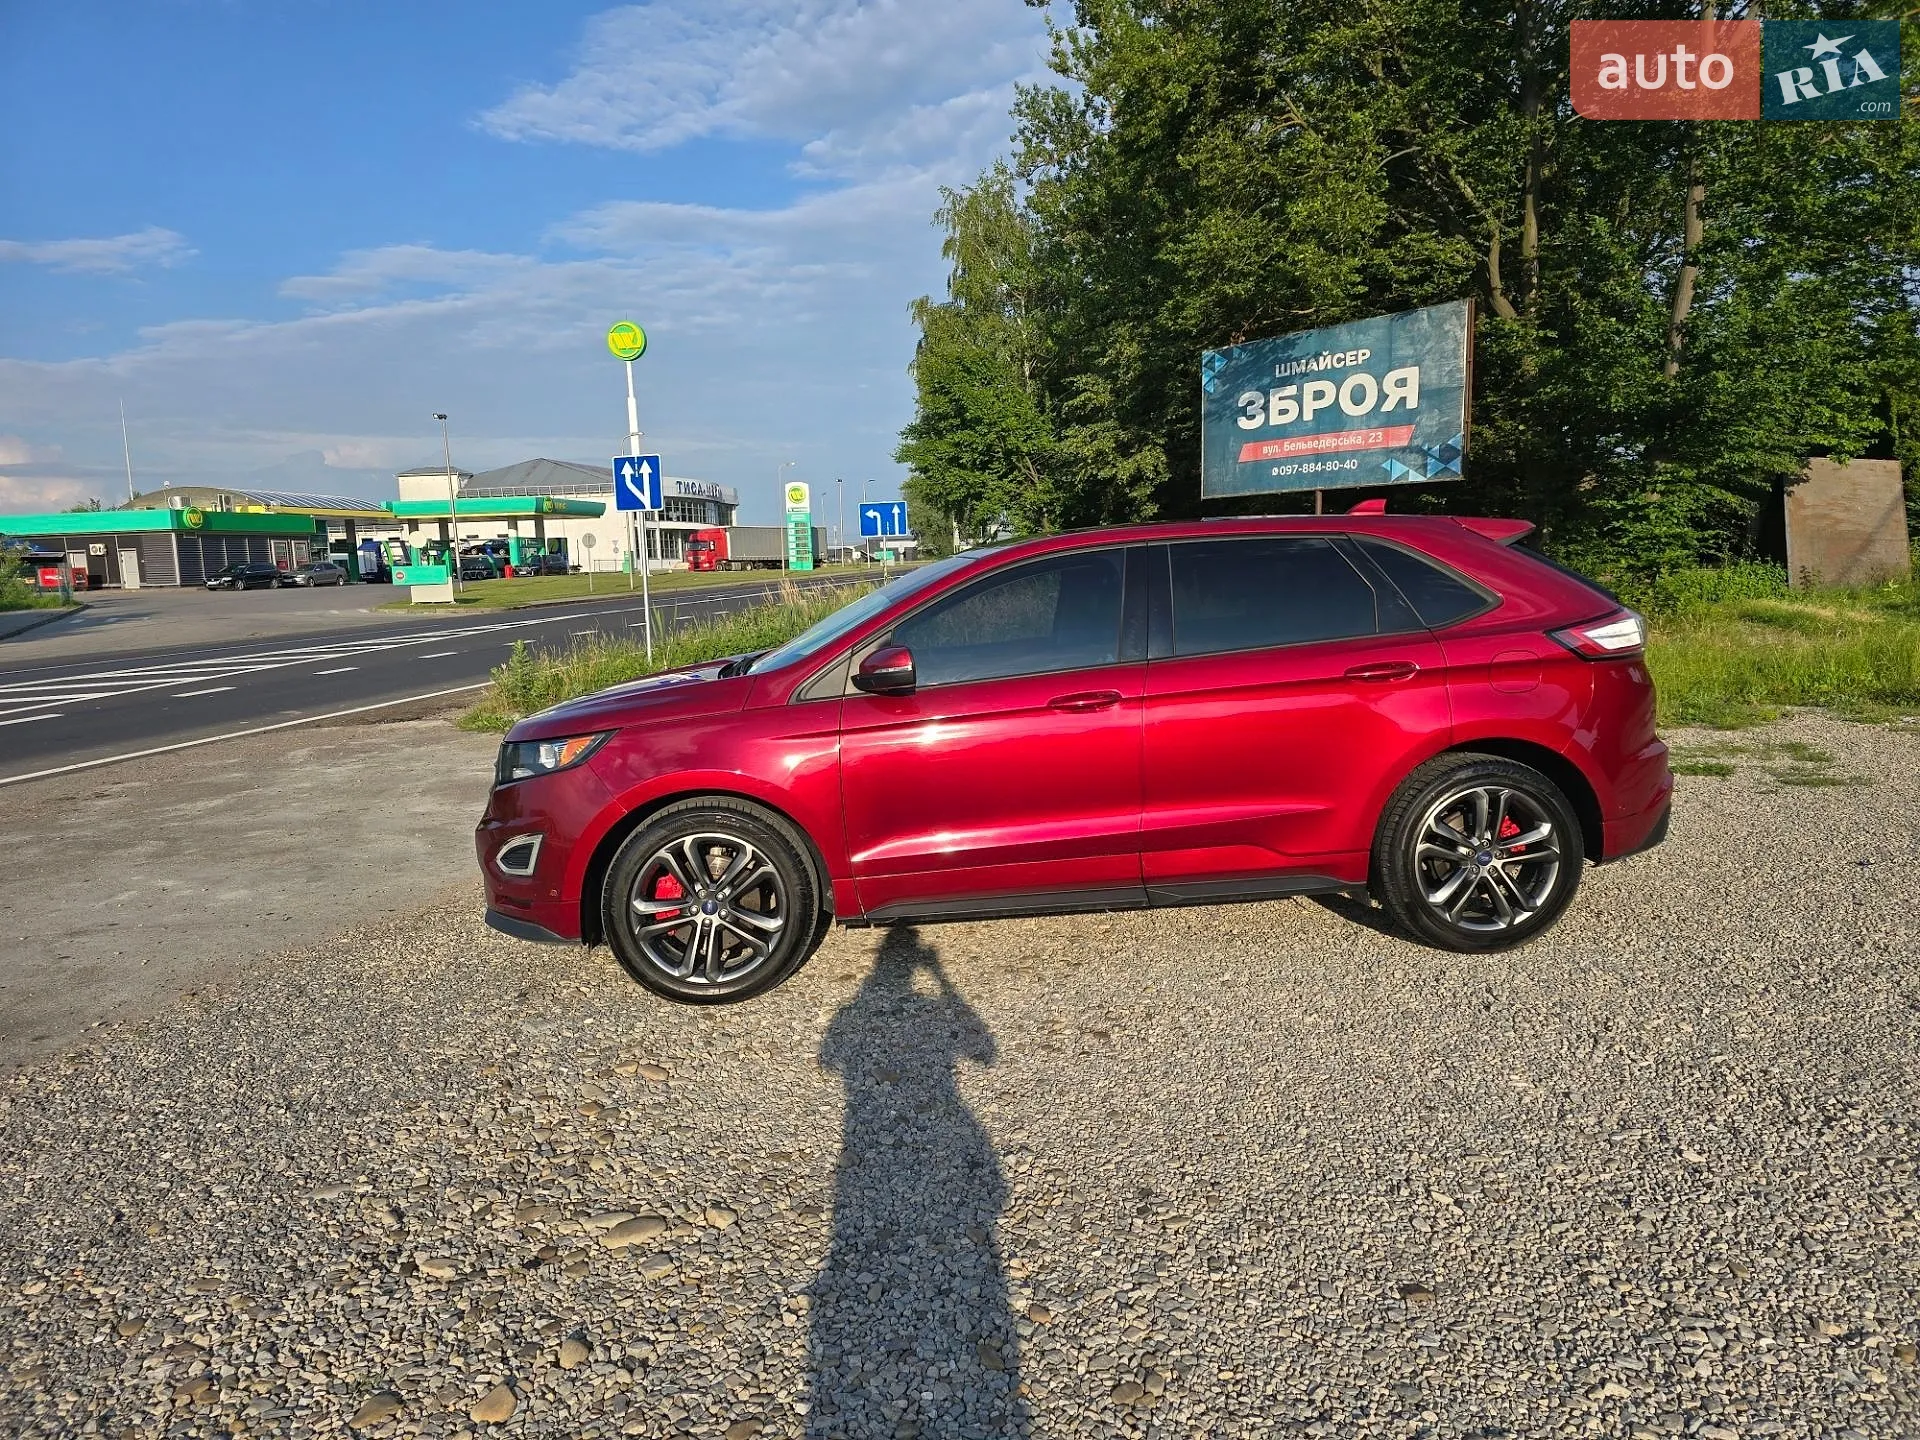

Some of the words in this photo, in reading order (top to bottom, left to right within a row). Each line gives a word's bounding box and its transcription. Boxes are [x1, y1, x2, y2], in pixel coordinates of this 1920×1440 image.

[1275, 349, 1371, 378] ШМАЙСЕР
[1237, 366, 1420, 431] ЗБРОЯ
[1262, 443, 1282, 456] вул.
[1283, 435, 1366, 453] Бельведерська,
[1367, 431, 1384, 444] 23
[1279, 459, 1358, 476] 097-884-80-40
